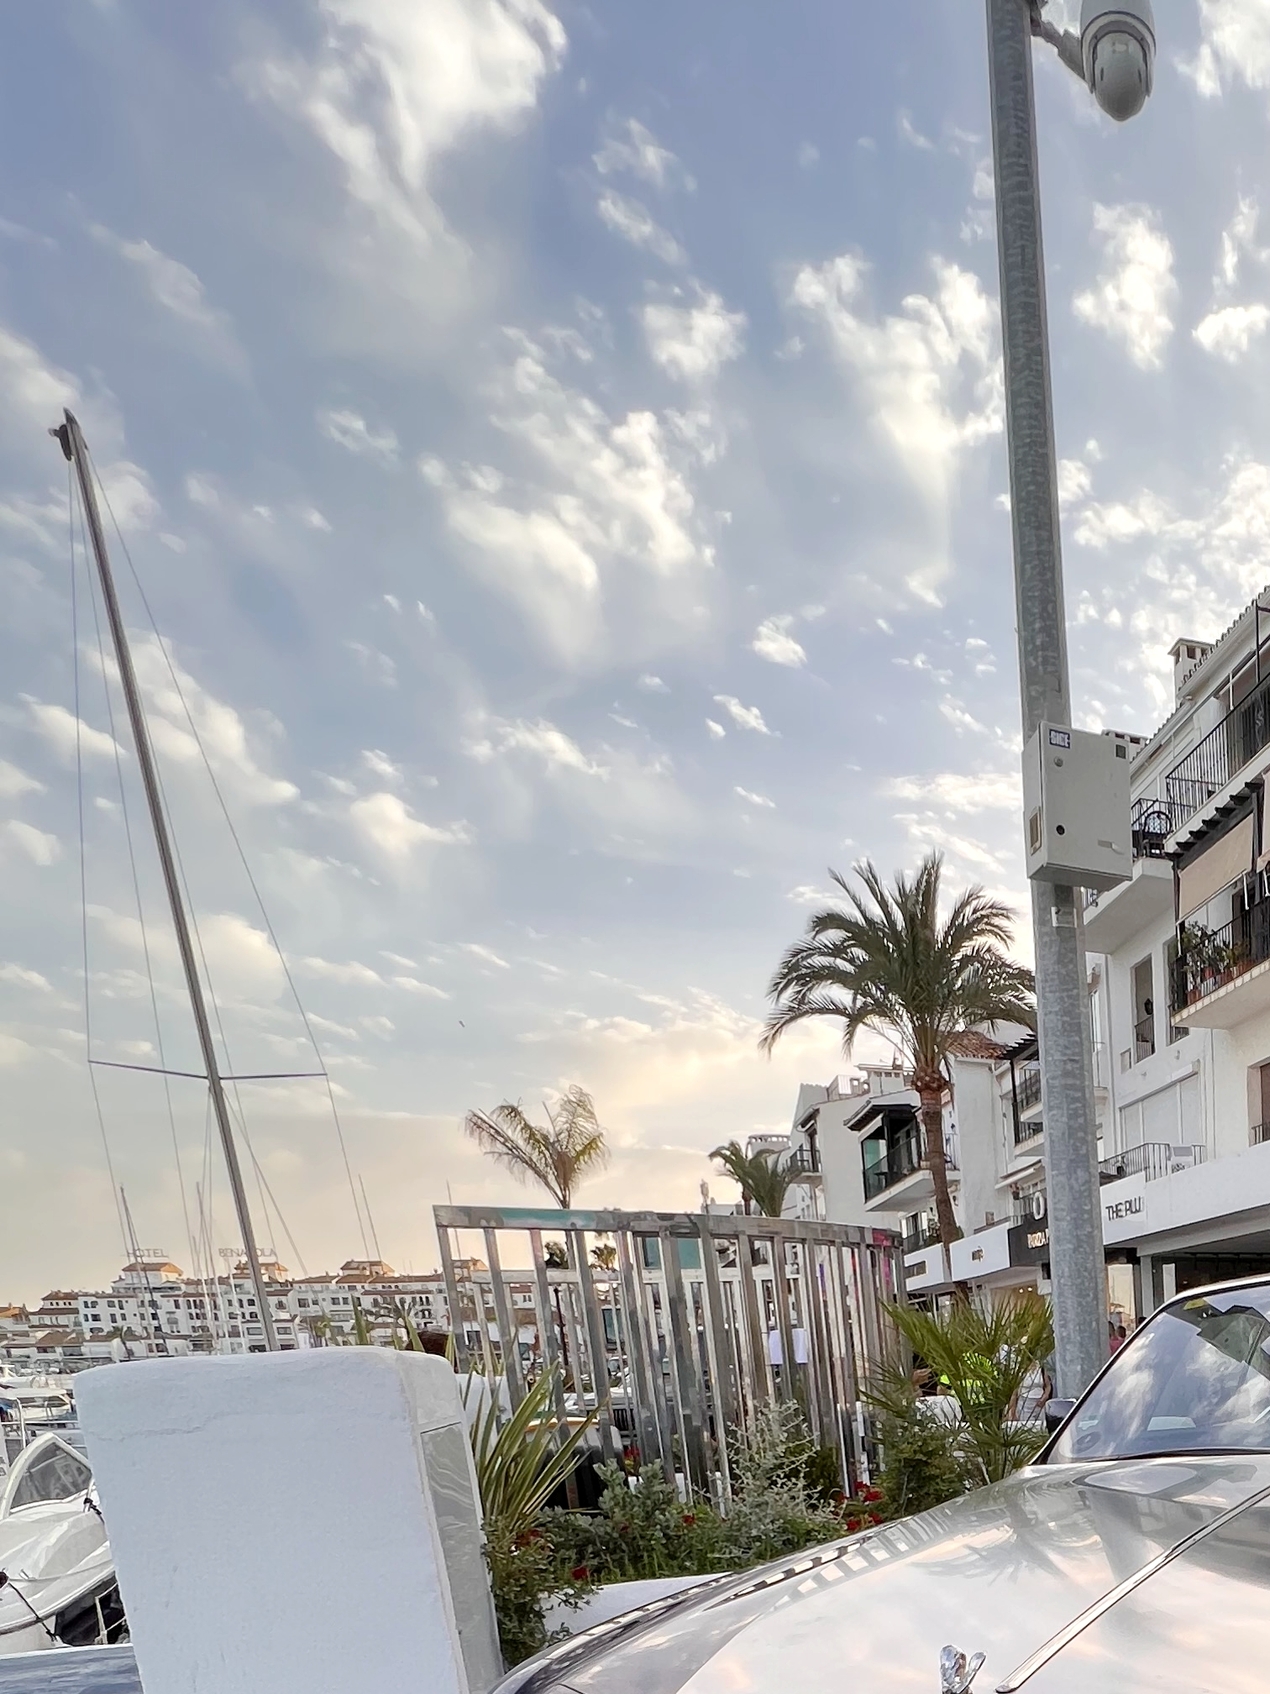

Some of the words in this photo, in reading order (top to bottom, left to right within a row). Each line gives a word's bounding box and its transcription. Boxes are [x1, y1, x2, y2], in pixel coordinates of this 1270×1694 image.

[1105, 1202, 1124, 1221] THE
[127, 1248, 168, 1258] HOTEL
[218, 1247, 277, 1258] BENAOLA
